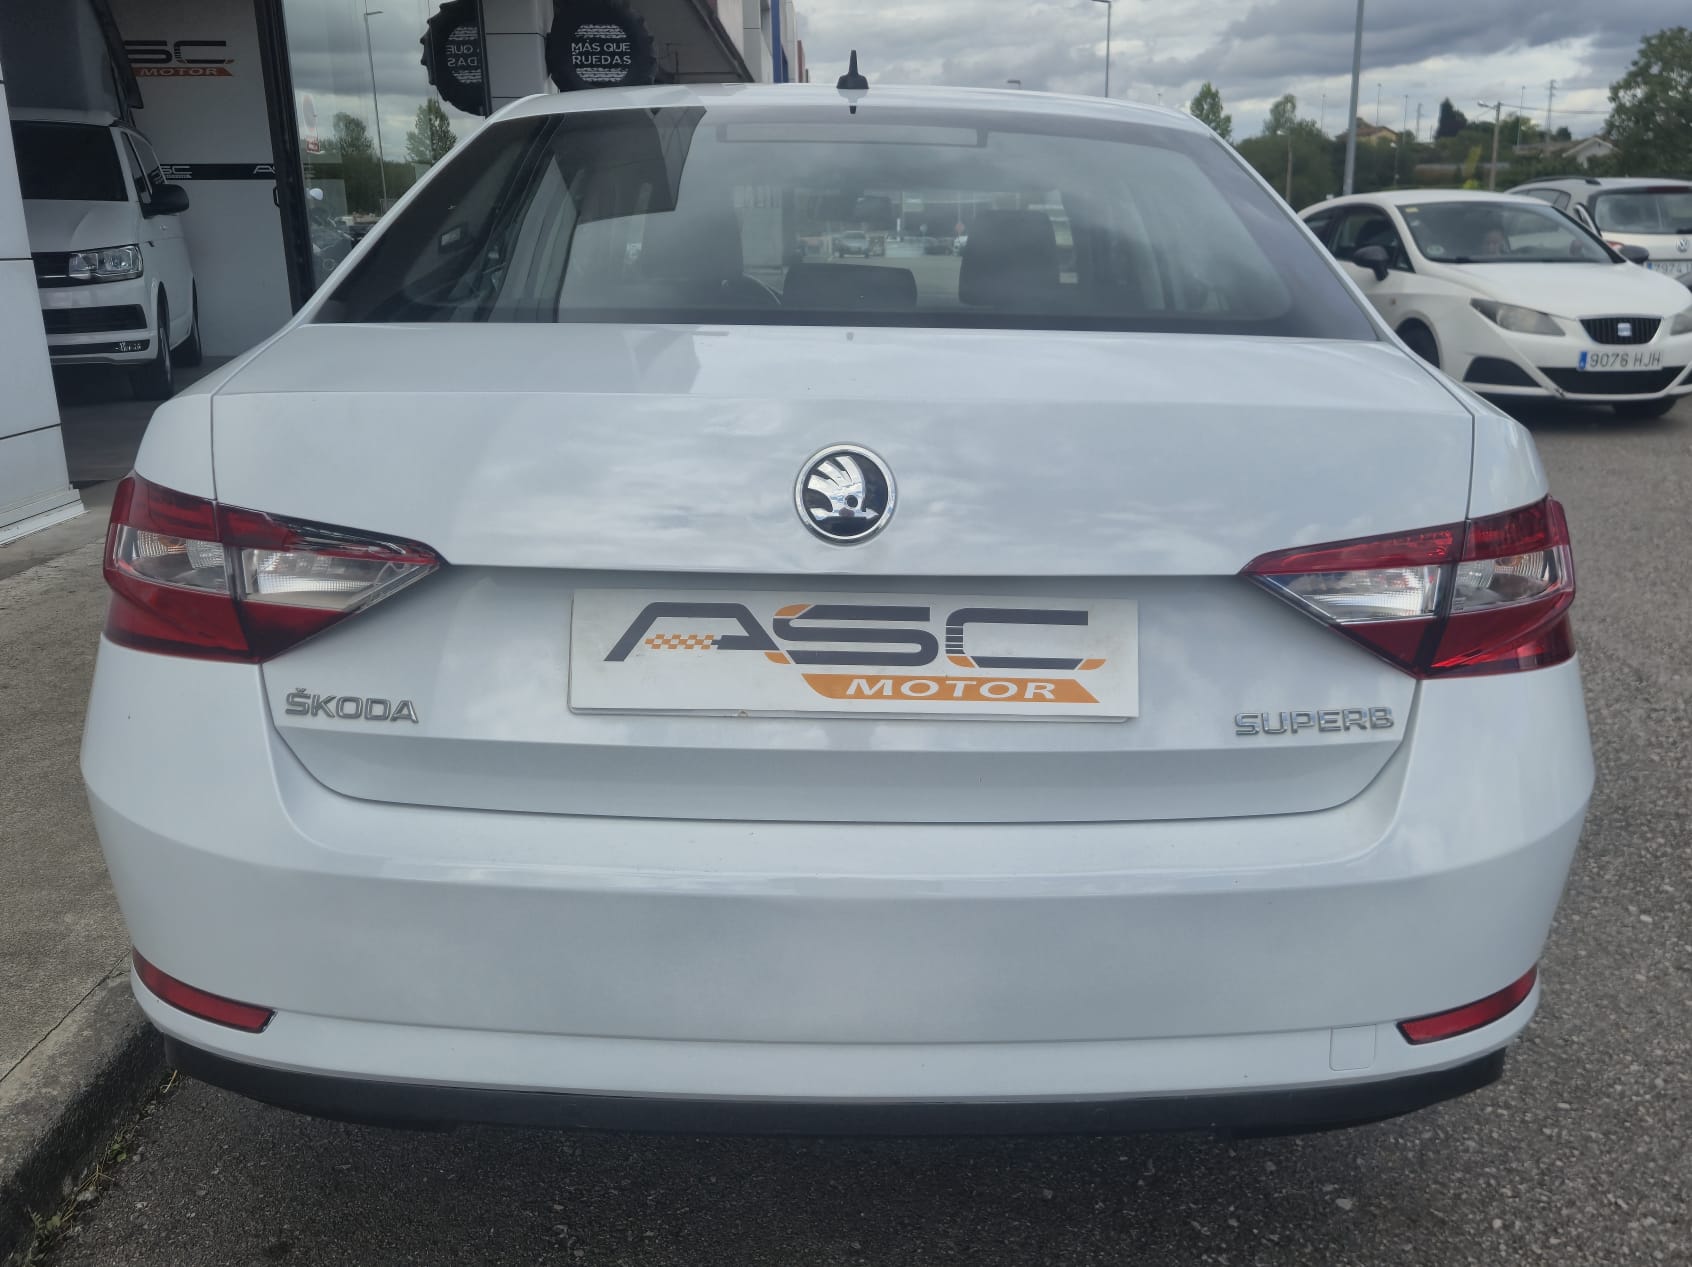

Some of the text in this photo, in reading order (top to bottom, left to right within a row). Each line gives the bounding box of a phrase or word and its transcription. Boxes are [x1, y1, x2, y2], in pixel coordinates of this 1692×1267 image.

[123, 40, 235, 65] SC
[571, 39, 631, 52] MÁS QUE
[572, 55, 632, 65] RUEDAS
[140, 68, 217, 76] MOTOR
[1589, 351, 1661, 368] 9076 HJH
[603, 601, 1107, 670] ASC
[844, 677, 1056, 699] MOTOR
[285, 687, 419, 724] ŠKODA
[1234, 706, 1394, 736] SUPERB
